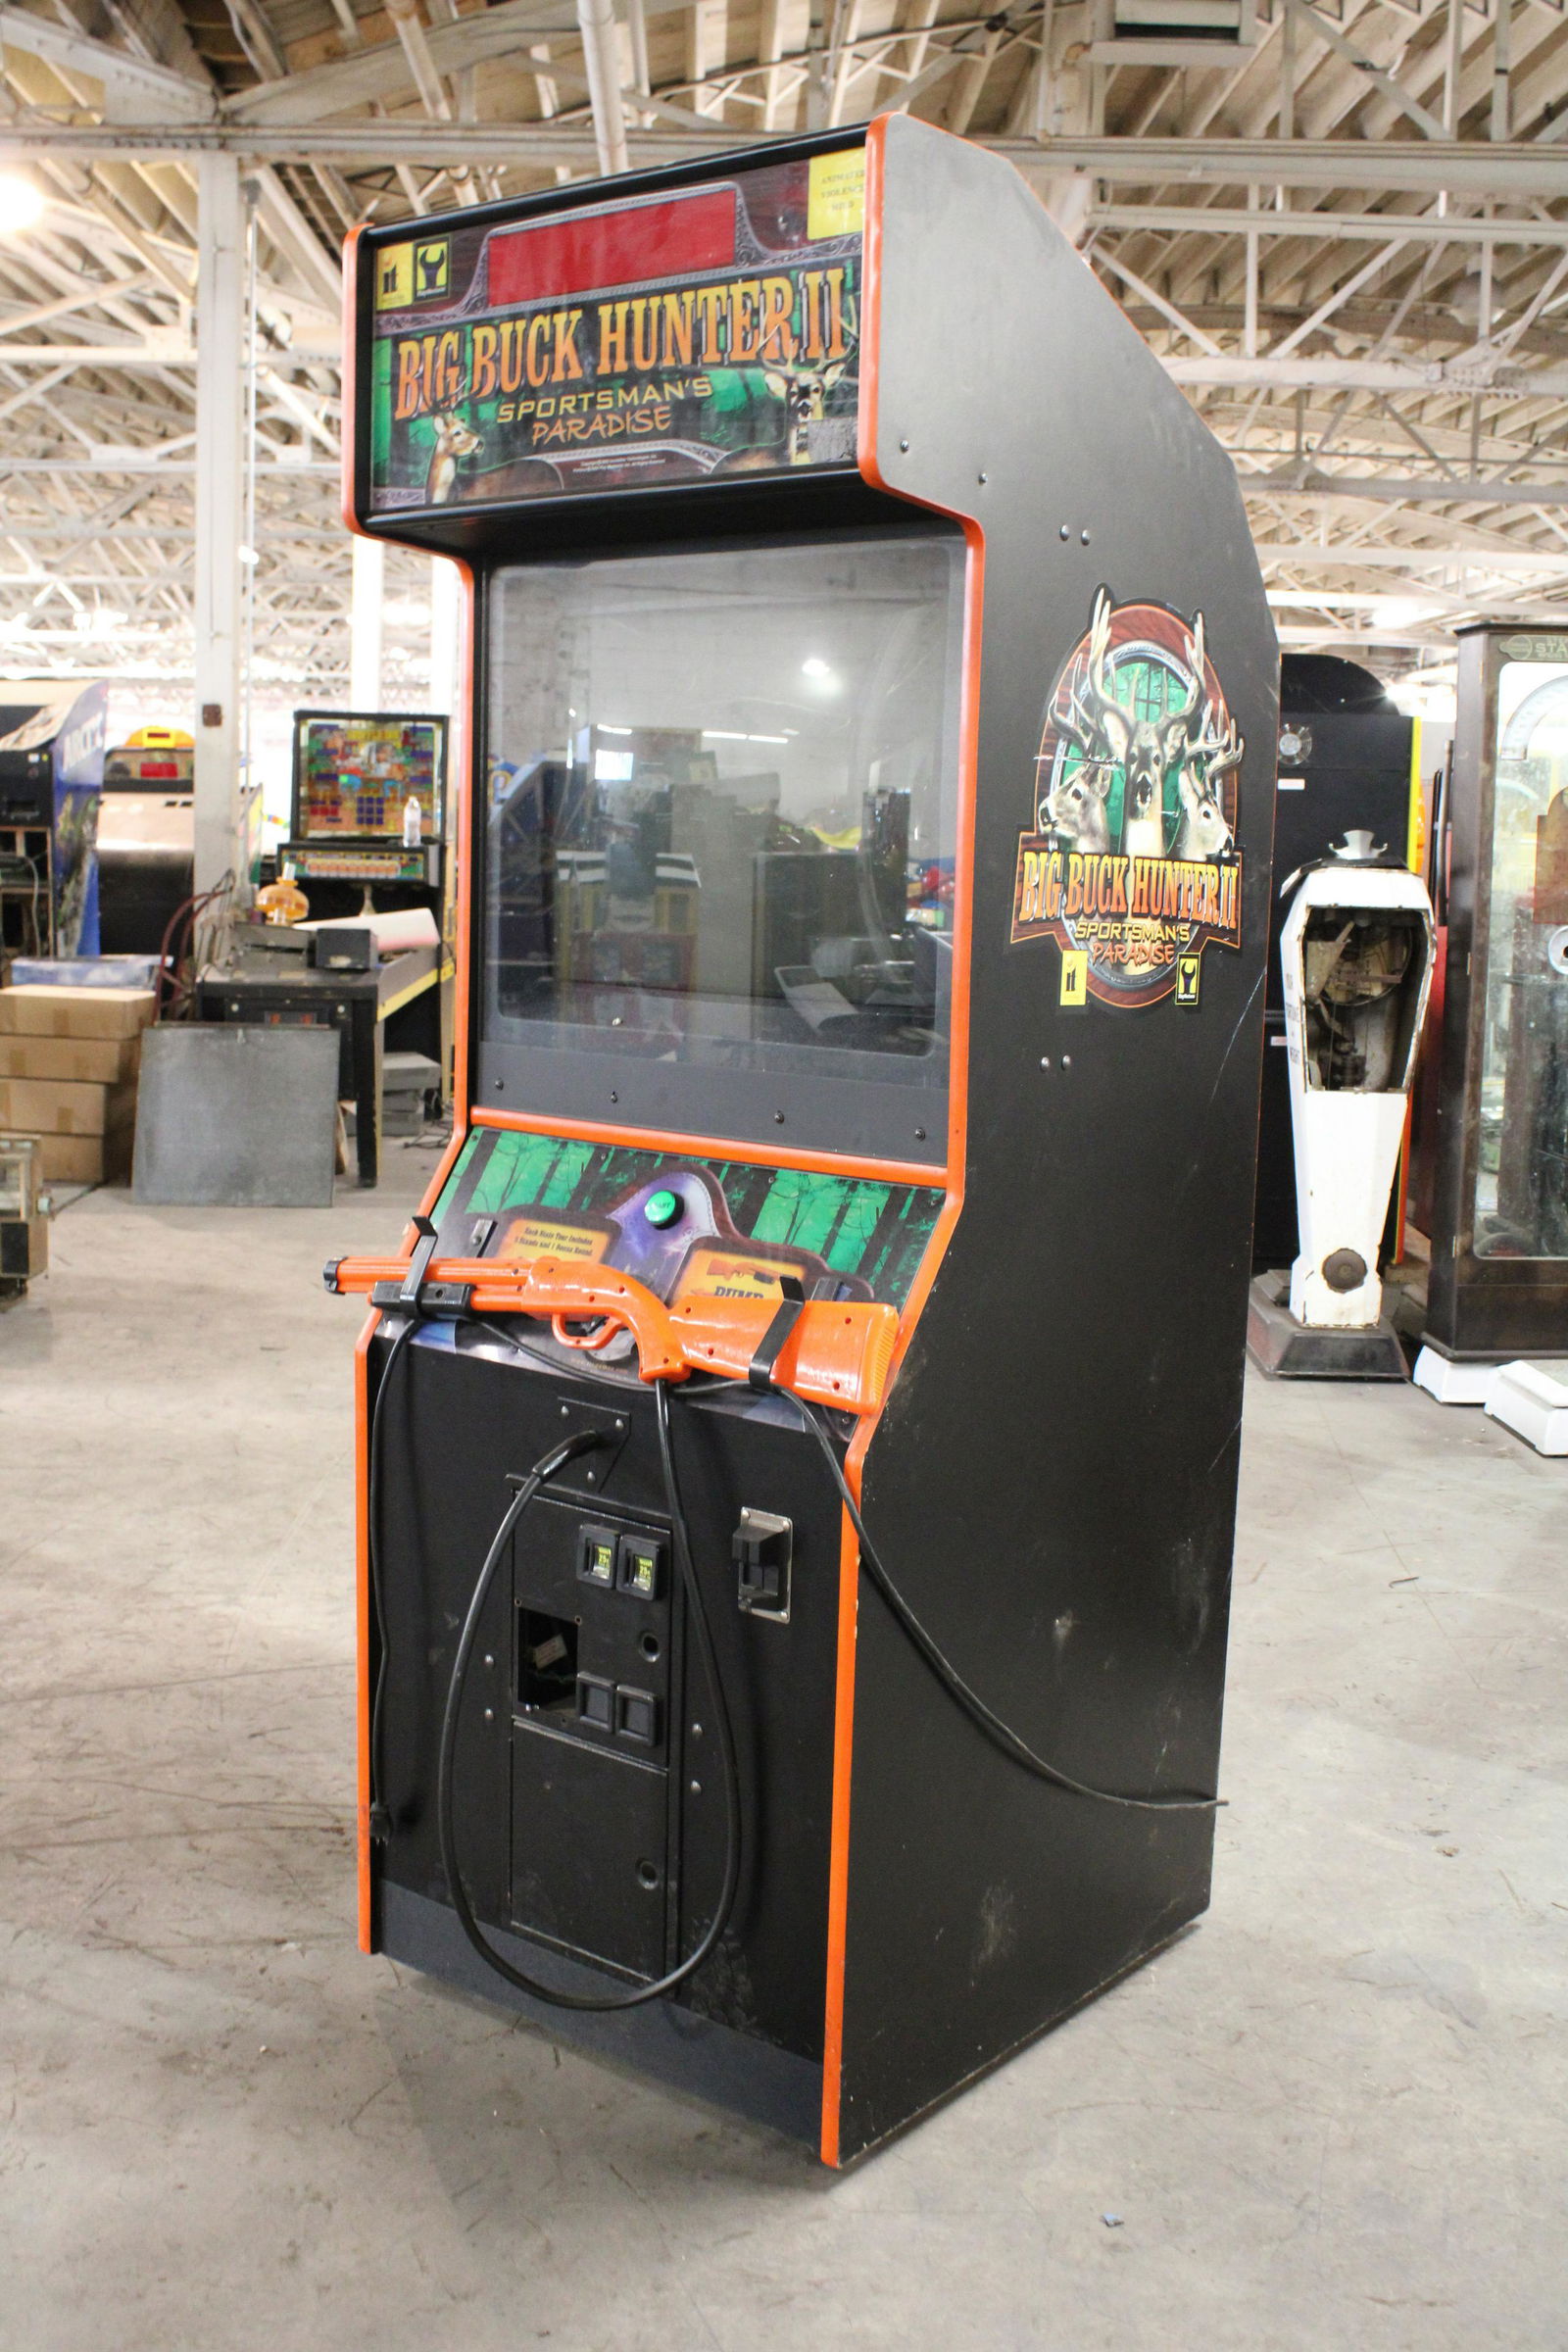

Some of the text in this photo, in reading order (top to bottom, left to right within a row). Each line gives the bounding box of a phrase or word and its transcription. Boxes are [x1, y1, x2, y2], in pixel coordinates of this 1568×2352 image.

[394, 267, 848, 421] BIG BUCK HUNTER II
[497, 375, 713, 423] SPORTSMAN'S
[531, 406, 672, 447] PARADISE
[1018, 851, 1239, 929] BIG BUCK HUNTER II
[1074, 921, 1192, 943] SPORTSMAN'S
[1092, 943, 1175, 968] PARADISE
